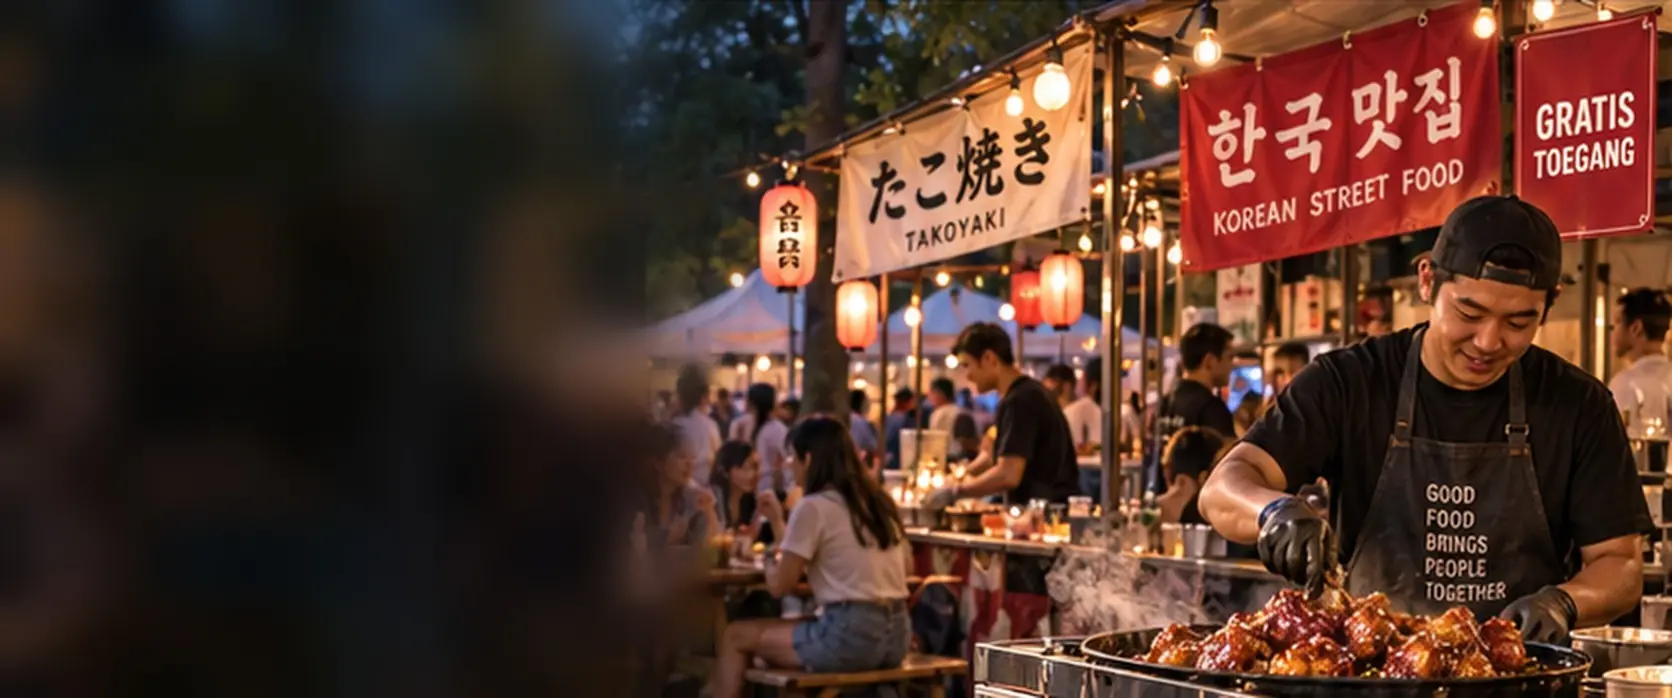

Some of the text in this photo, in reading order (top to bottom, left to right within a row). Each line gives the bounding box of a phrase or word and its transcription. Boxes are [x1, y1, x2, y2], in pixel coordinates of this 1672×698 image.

[1208, 56, 1462, 187] 한국 맛집
[1536, 91, 1635, 141] GRATIS
[868, 117, 1052, 224] たこ焼き
[1533, 135, 1635, 179] TOEGANG
[1213, 158, 1464, 236] KOREAN STREET FOOD
[905, 206, 1006, 253] TAKOYAKI
[1426, 483, 1476, 505] GOOD
[1426, 508, 1475, 530] FOOD
[1426, 532, 1488, 554] BRINGS
[1425, 556, 1487, 579] PEOPLE
[1425, 581, 1507, 603] TOGETHER
